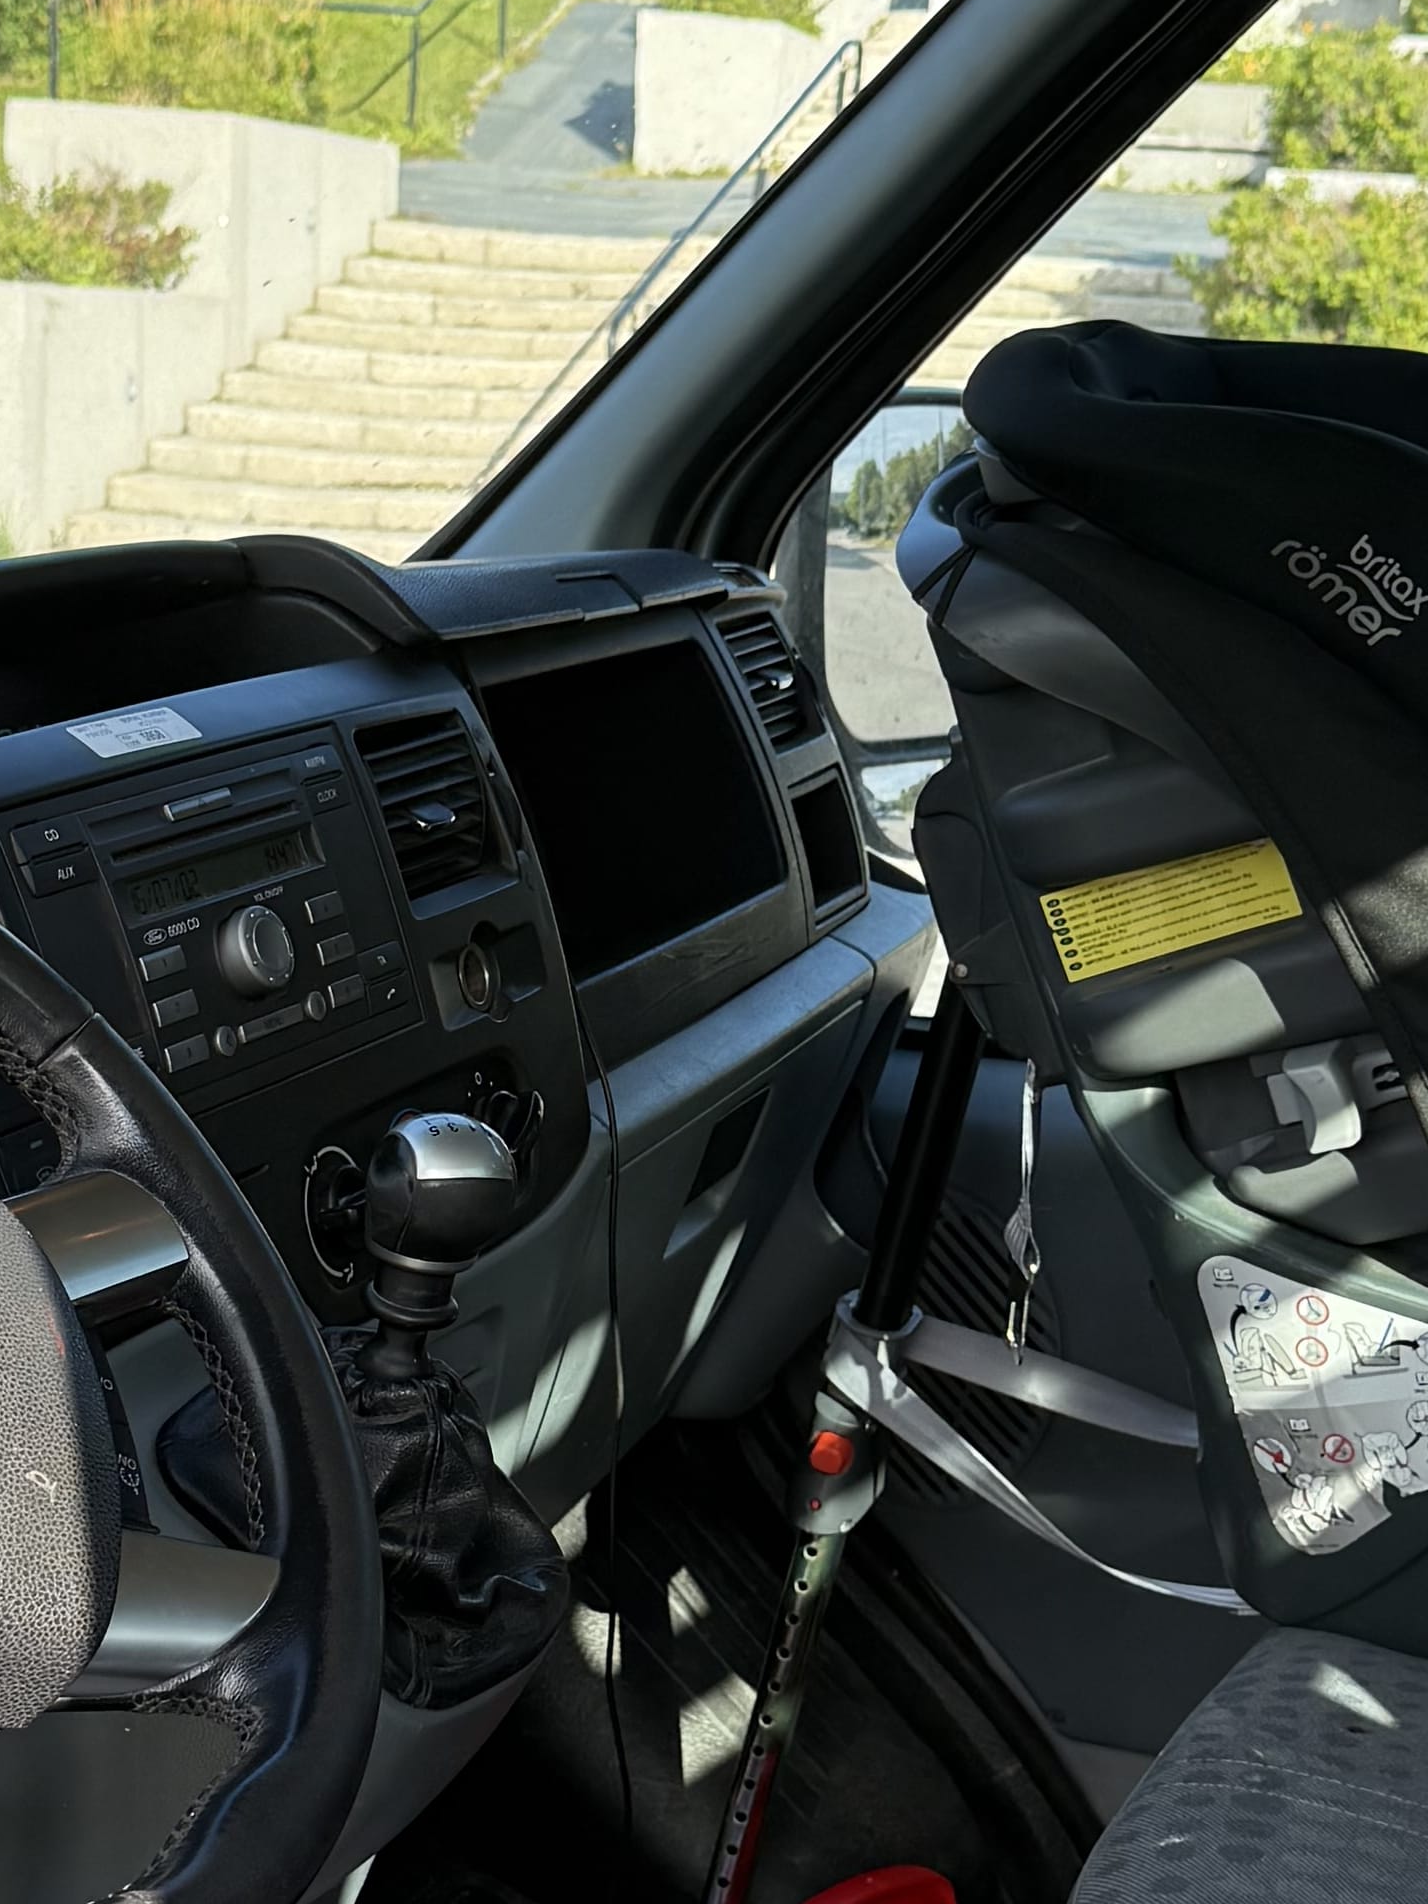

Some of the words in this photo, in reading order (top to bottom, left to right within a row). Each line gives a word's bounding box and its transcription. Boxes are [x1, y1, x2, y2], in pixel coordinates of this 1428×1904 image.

[1272, 538, 1402, 647] römer
[44, 828, 60, 842] CD
[57, 865, 76, 880] AUX
[187, 916, 201, 931] CD
[428, 1125, 441, 1137] 5
[118, 1452, 137, 1471] ON
